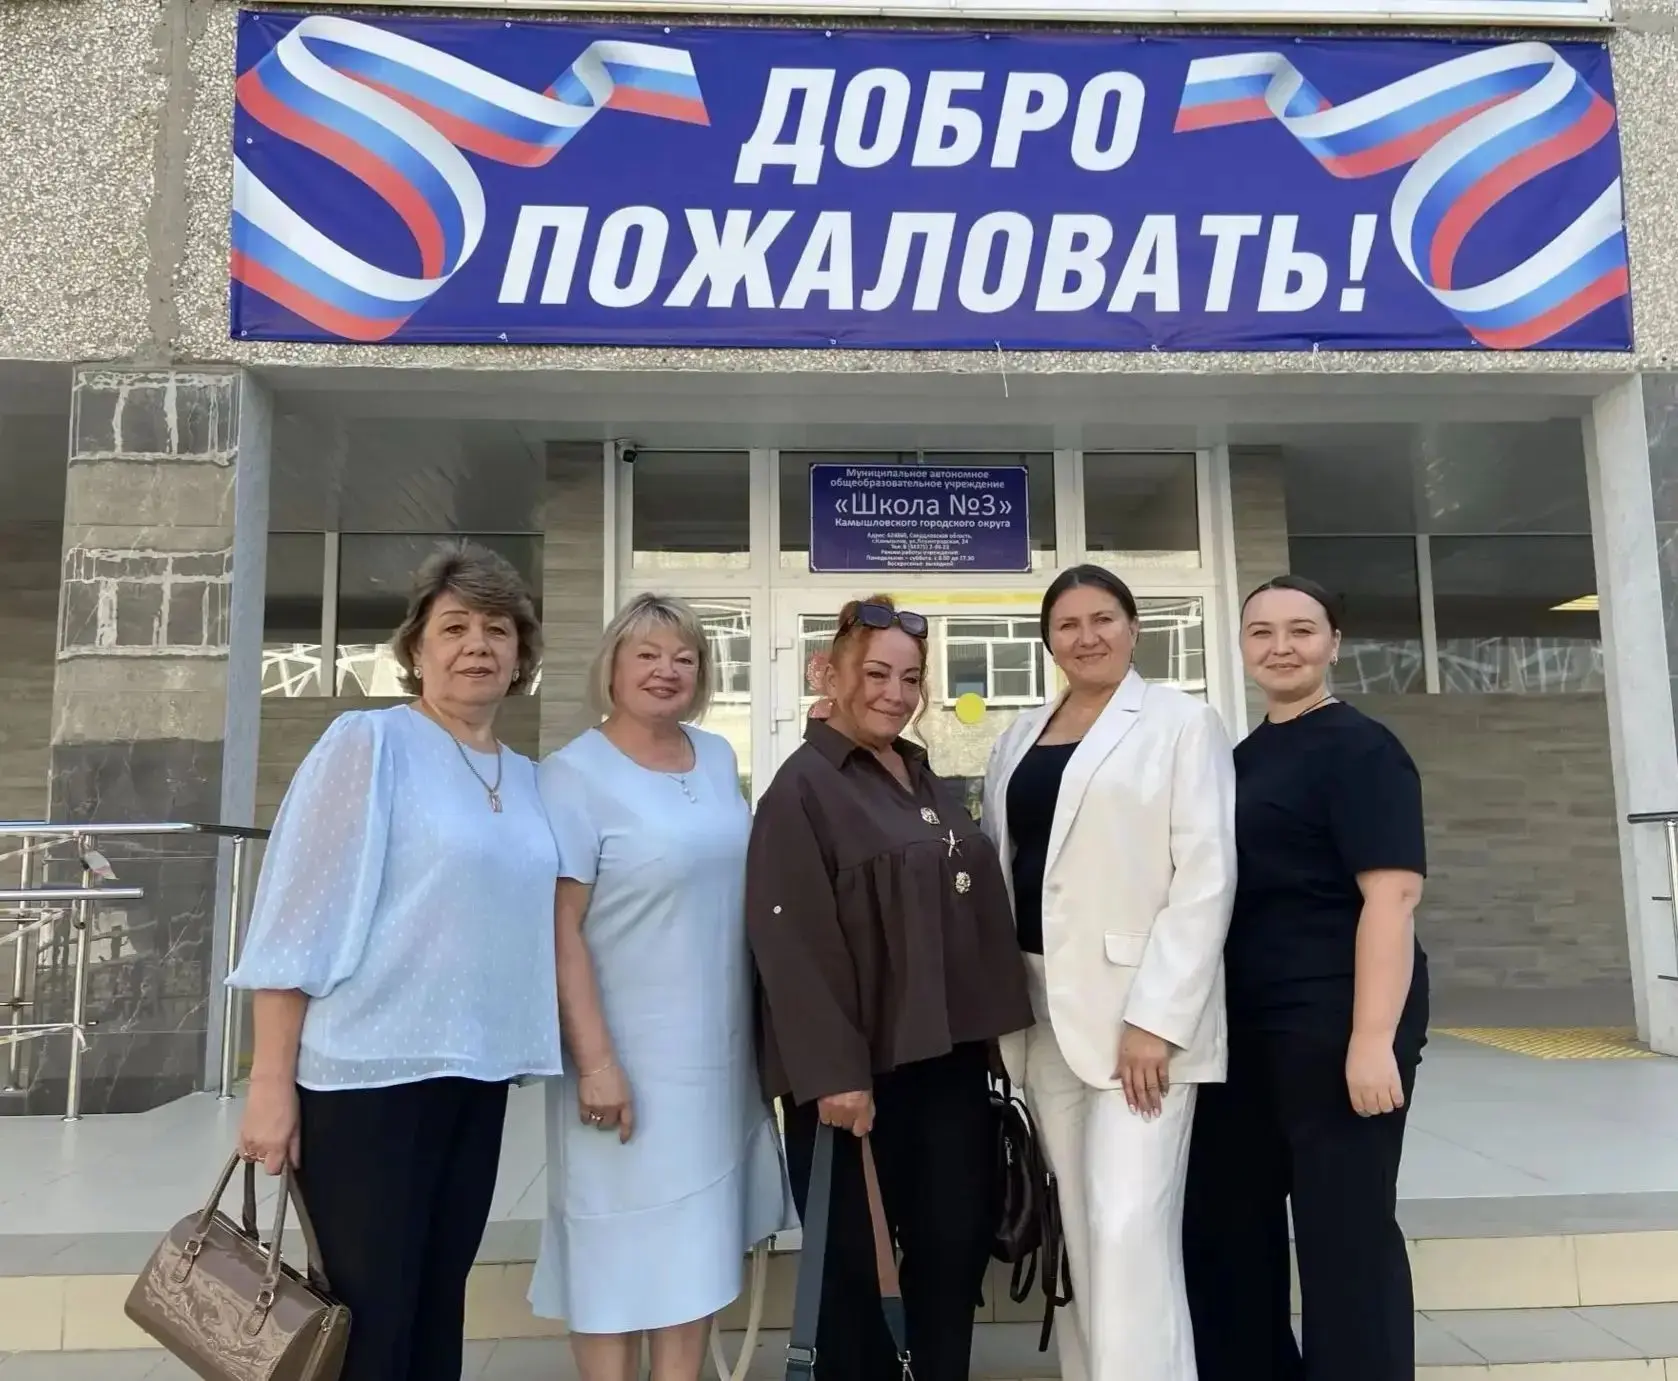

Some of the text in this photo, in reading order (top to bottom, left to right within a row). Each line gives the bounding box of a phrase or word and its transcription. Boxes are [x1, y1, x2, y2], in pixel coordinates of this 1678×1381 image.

[733, 66, 1147, 186] ДОБРО
[497, 204, 1380, 314] ПОЖАЛОВАТЬ!
[846, 468, 989, 479] Муниципальное автономное
[830, 477, 1005, 491] общеобразовательное учреждение
[835, 493, 1012, 516] «Школа №3»
[835, 518, 1011, 529] Камышловского городского округа
